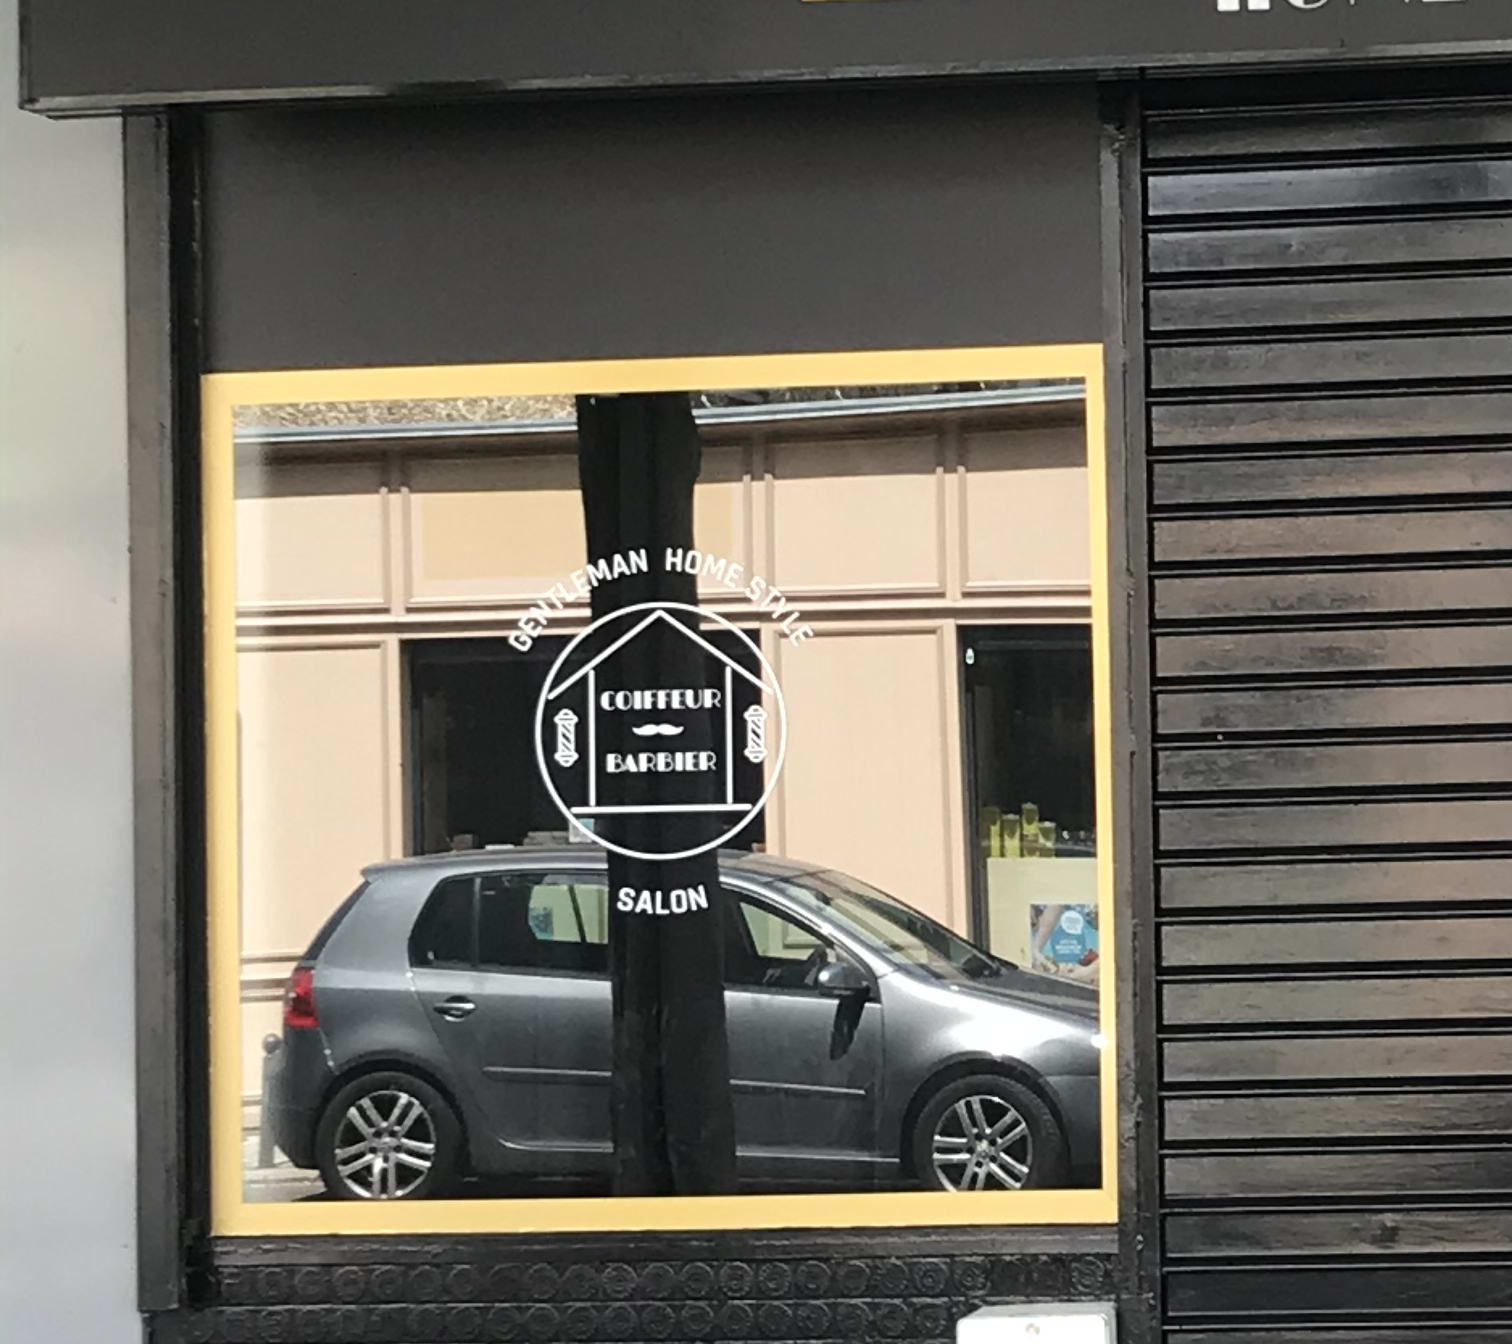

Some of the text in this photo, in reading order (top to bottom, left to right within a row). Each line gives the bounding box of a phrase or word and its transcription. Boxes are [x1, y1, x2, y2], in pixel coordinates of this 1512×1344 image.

[508, 547, 814, 652] GENTLEMAN HOME STYLE
[600, 689, 721, 711] COIFFEUR
[606, 751, 717, 773] BARBIER
[616, 885, 709, 915] SALON
